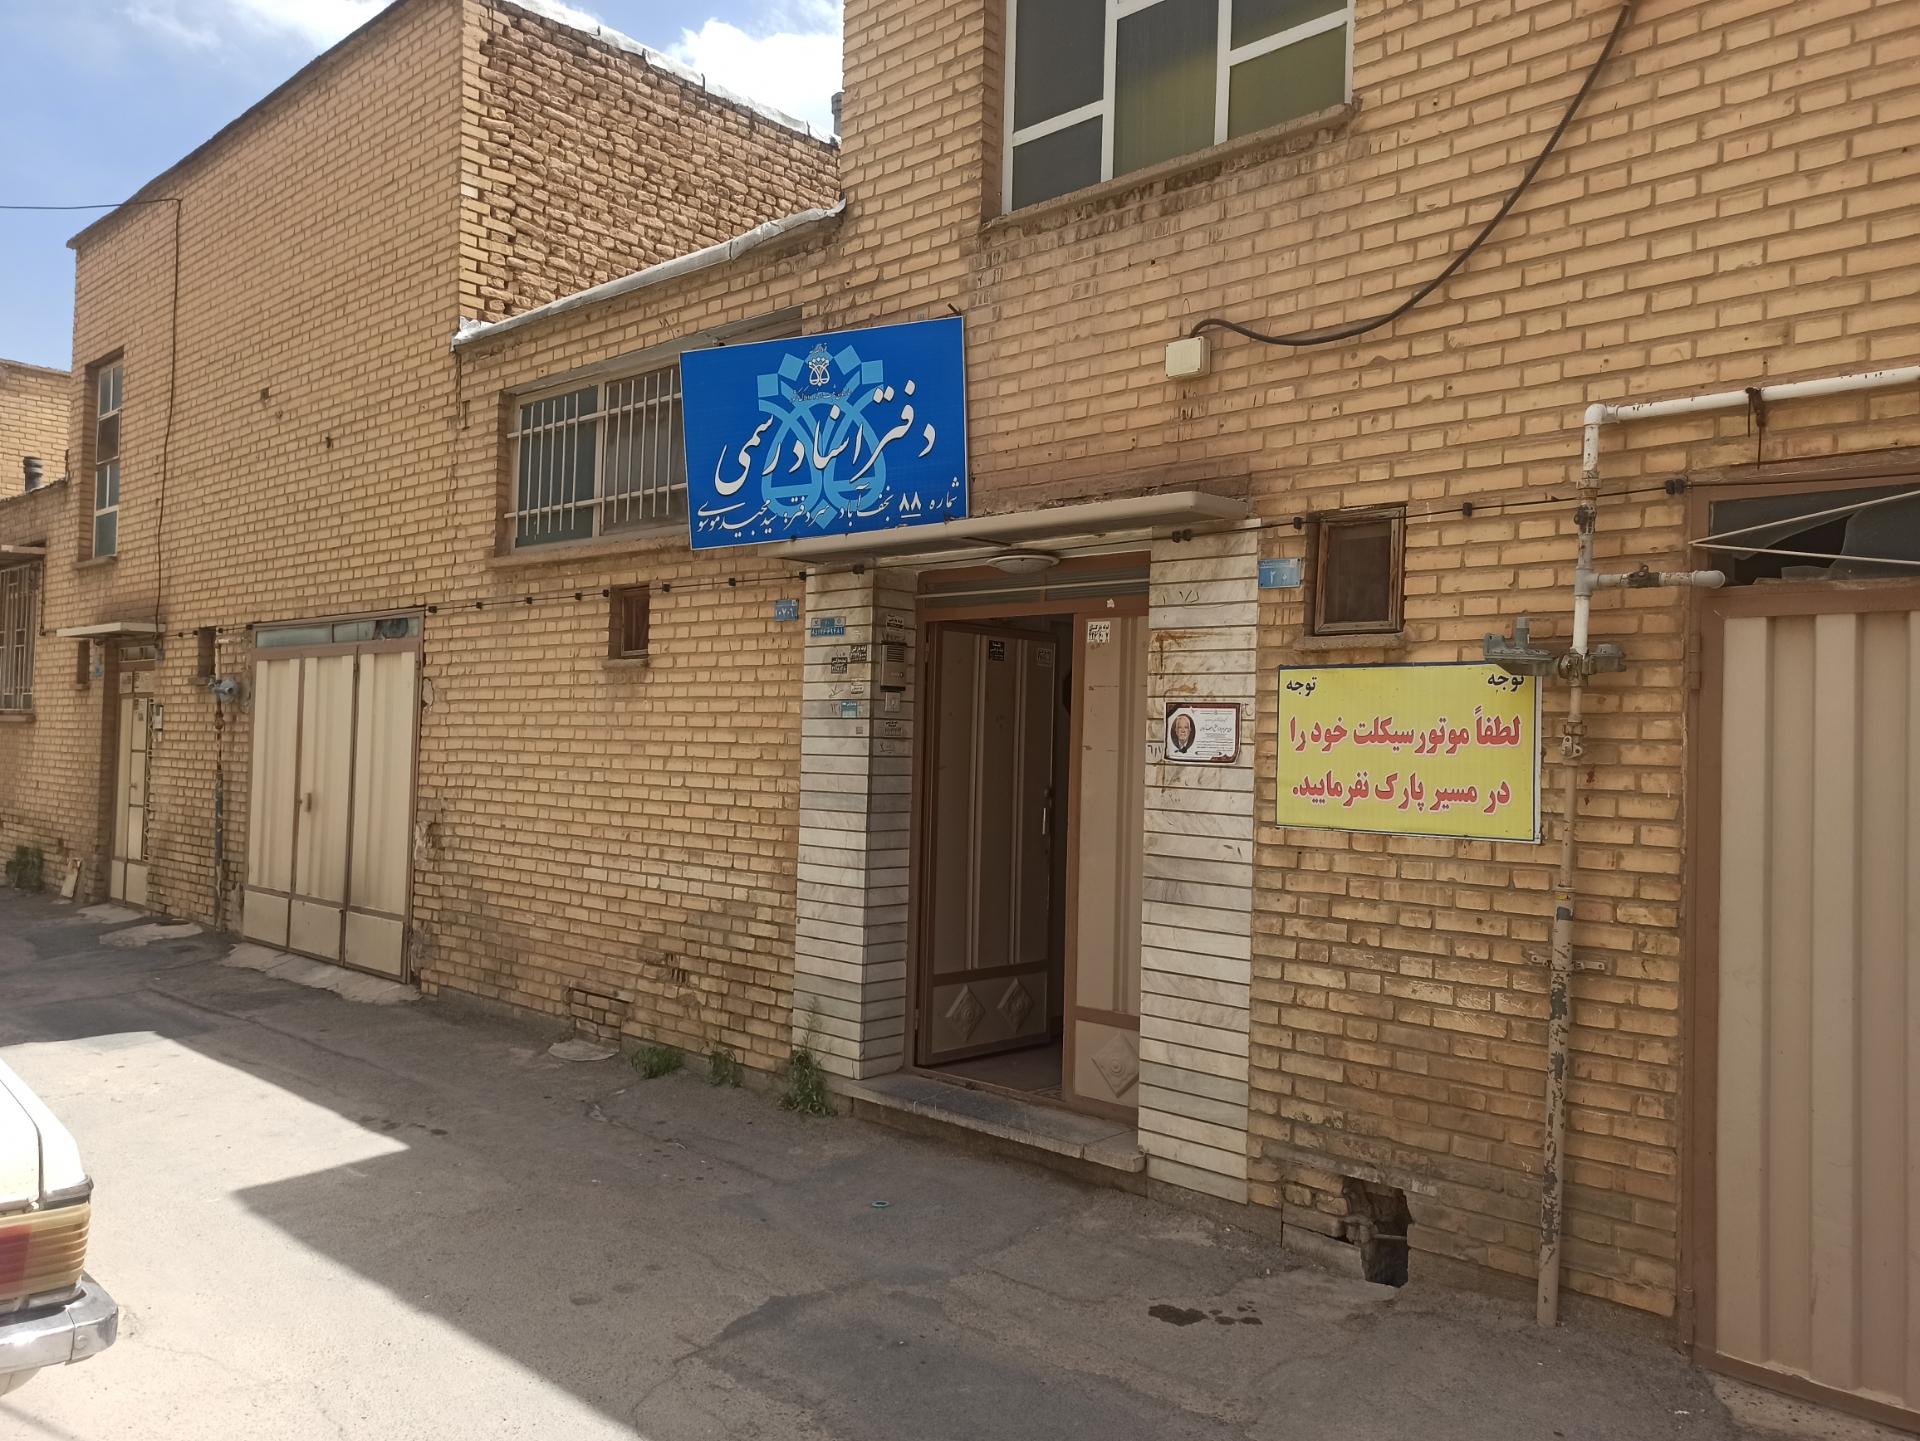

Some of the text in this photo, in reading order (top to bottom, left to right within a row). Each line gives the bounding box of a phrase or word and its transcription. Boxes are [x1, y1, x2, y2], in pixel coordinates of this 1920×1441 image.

[714, 379, 936, 496] دفتر اسناد رسمی
[839, 481, 869, 527] آباد
[857, 485, 894, 522] نجف
[899, 491, 922, 513] ۸۸
[929, 476, 960, 510] شماره
[697, 500, 746, 532] موسوی
[718, 499, 771, 538] مجید
[760, 513, 778, 534] سید
[1286, 676, 1317, 696] توجه
[1289, 716, 1306, 752] را
[1311, 717, 1348, 752] خود
[1475, 706, 1521, 746] لطفاً
[1375, 773, 1424, 812] پارک
[1429, 784, 1478, 812] مسیر
[1483, 781, 1511, 814] در
